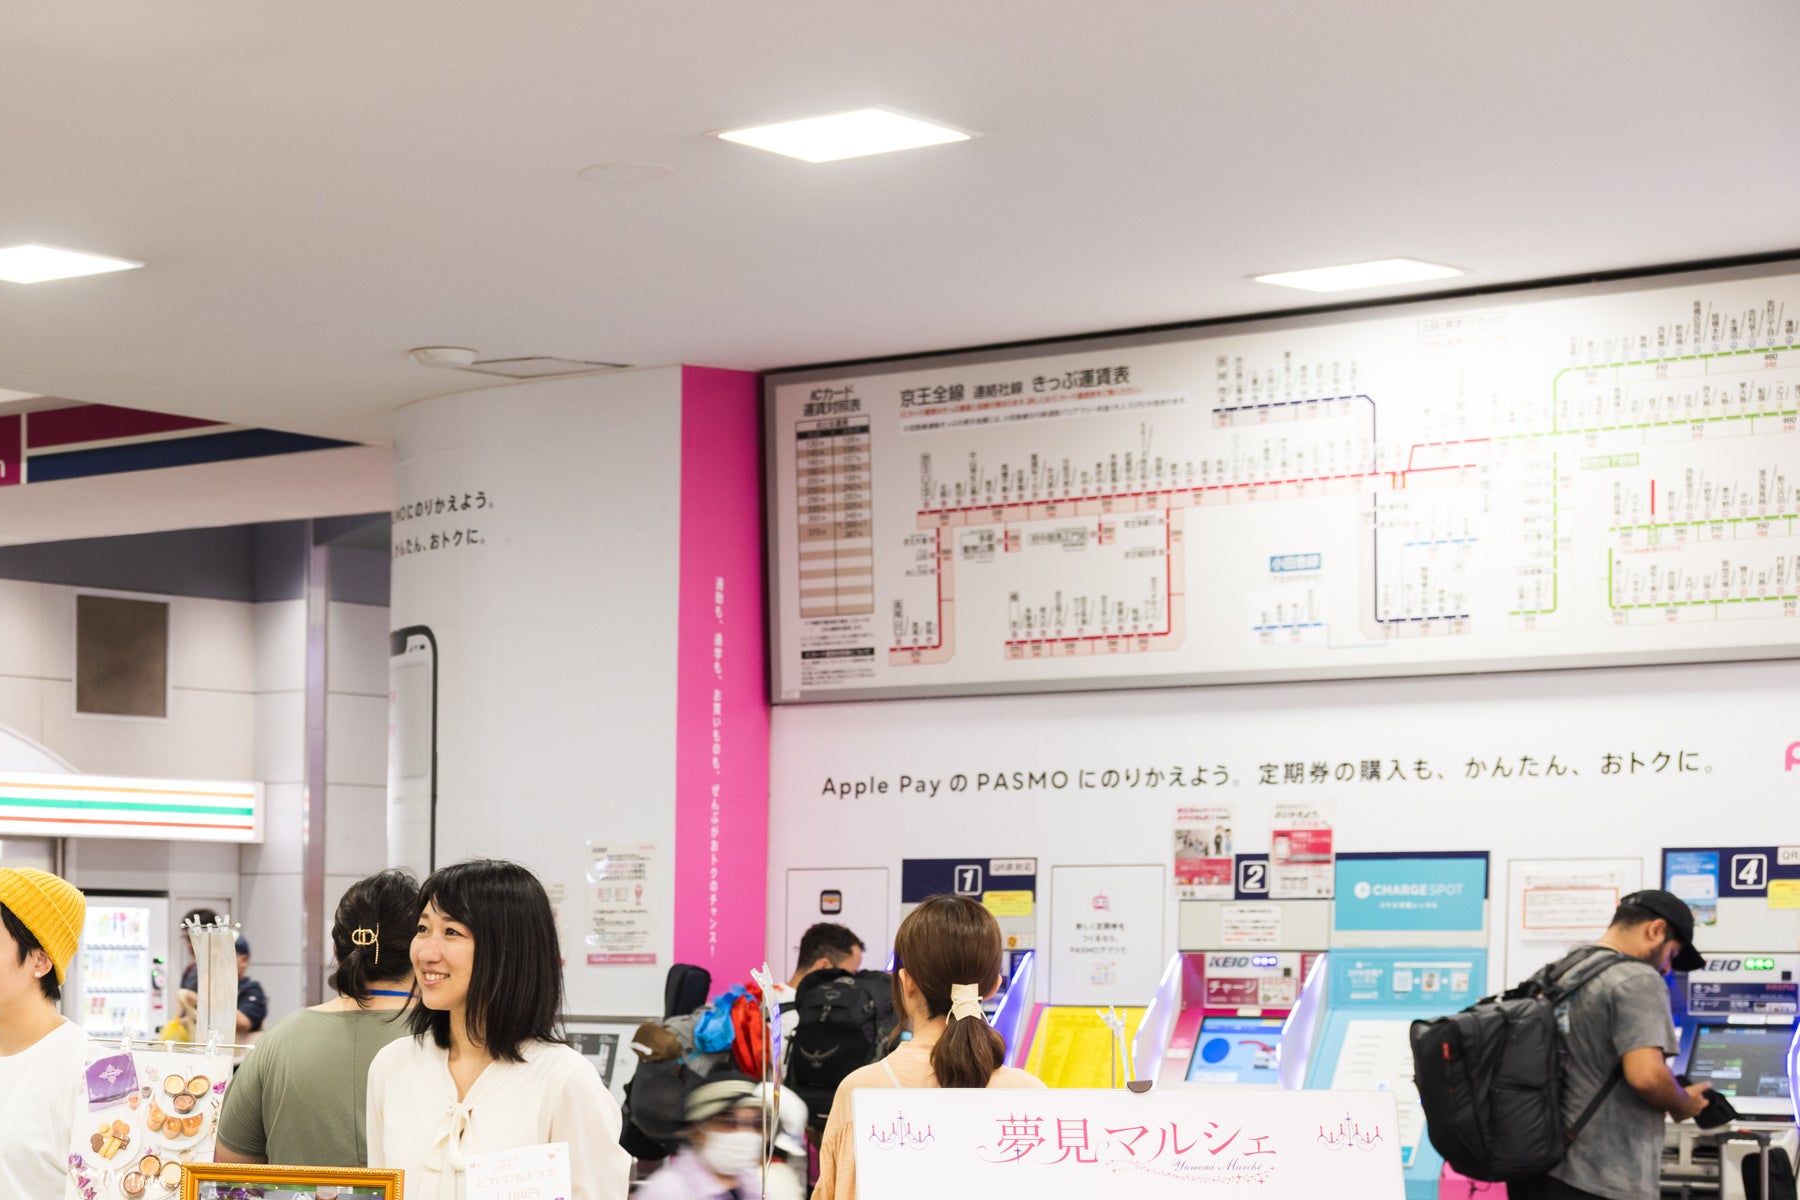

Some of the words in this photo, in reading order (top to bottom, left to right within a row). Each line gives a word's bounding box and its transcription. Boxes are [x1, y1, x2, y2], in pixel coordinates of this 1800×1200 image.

[822, 776, 888, 799] Apple
[900, 775, 940, 798] Pay
[978, 771, 1068, 791] PASMO
[962, 870, 974, 892] 1
[1244, 865, 1264, 889] 2
[1738, 859, 1758, 885] 4
[1209, 956, 1249, 968] KEIO
[1209, 981, 1257, 994] チャージ
[977, 1112, 1277, 1165] 夢見マルシェ
